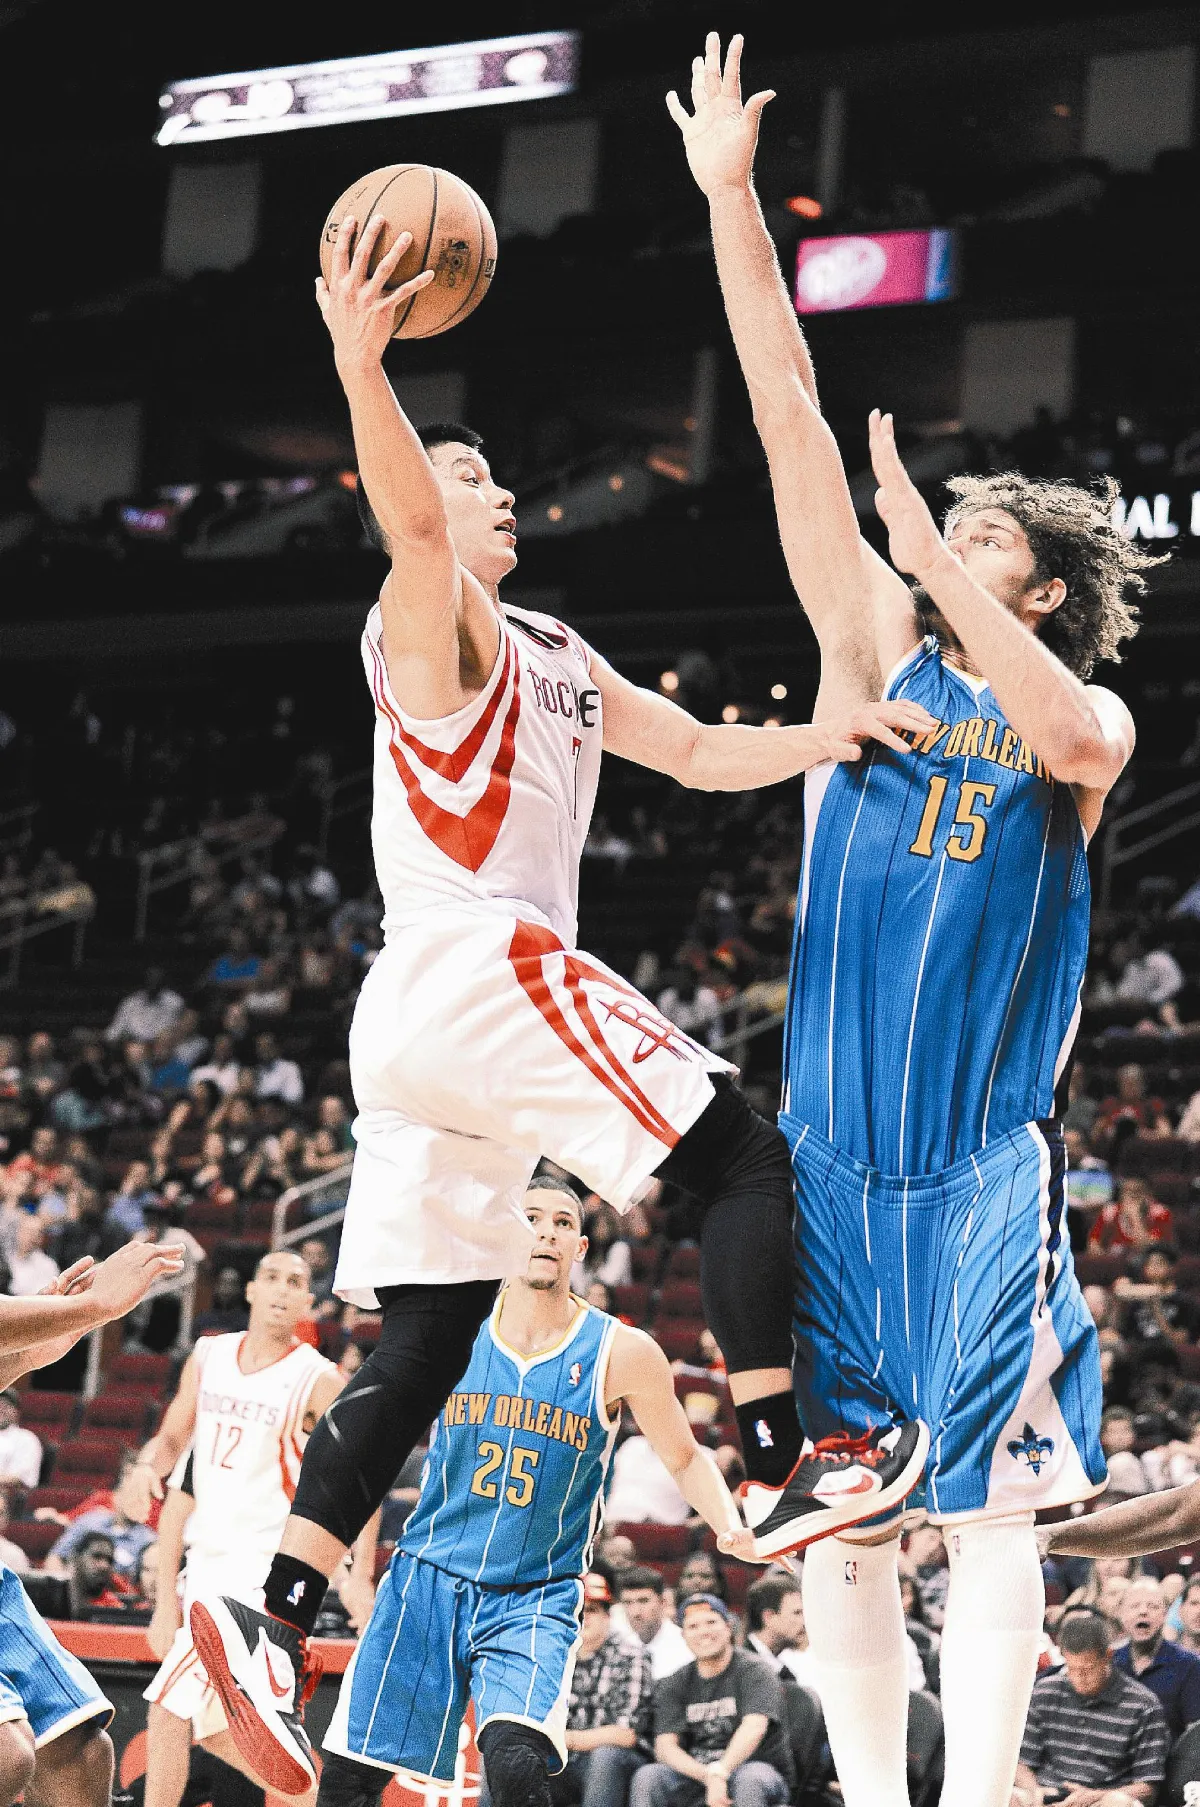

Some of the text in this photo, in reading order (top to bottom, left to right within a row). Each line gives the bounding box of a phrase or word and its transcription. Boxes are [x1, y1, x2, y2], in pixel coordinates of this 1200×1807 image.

[908, 775, 998, 863] 15
[211, 1421, 243, 1469] 12
[443, 1392, 591, 1452] NEW ORLEANS
[470, 1440, 540, 1508] 25
